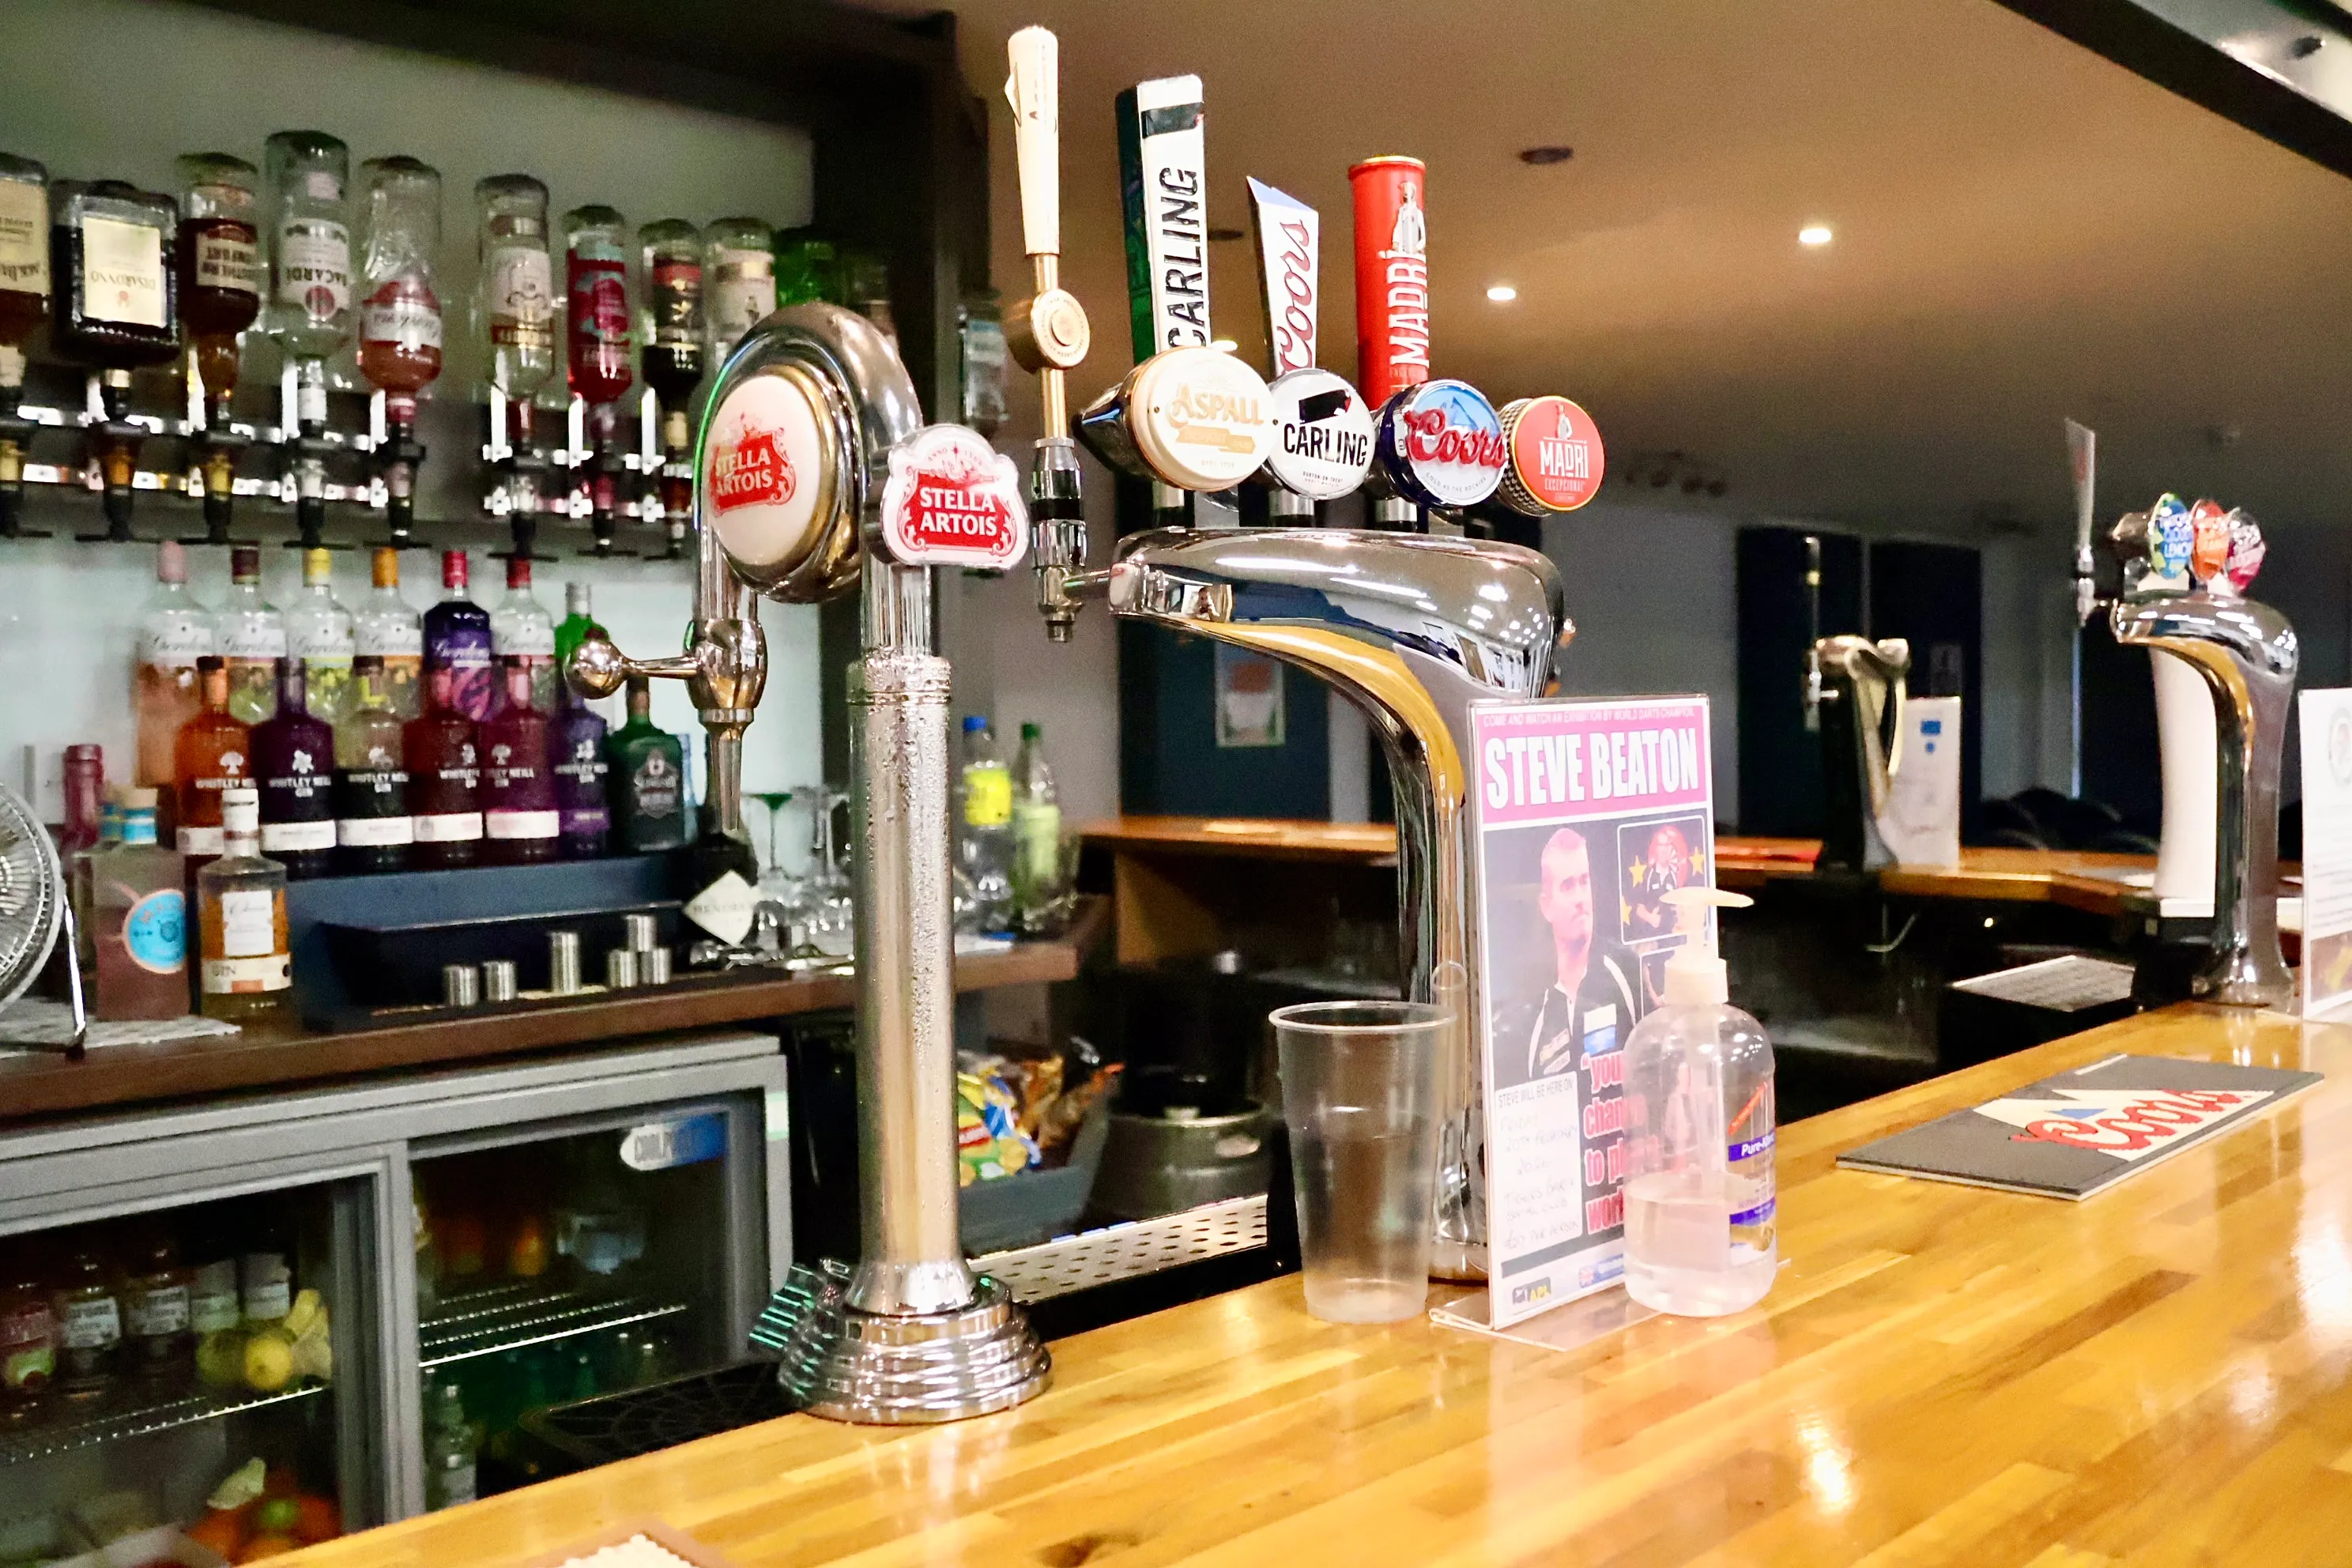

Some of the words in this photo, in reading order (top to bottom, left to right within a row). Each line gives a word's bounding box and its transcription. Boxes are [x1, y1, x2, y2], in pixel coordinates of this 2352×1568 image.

[1159, 167, 1207, 349] CARLING
[1276, 218, 1314, 375] Coors
[1165, 382, 1265, 429] ASPALL
[1283, 422, 1369, 468] CARLING
[1404, 408, 1506, 469] Coors
[714, 447, 771, 477] STELLA
[715, 468, 774, 497] ARTOIS
[919, 486, 996, 514] STELLA
[920, 511, 997, 537] ARTOIS
[1484, 733, 1585, 810] STEVE
[1589, 727, 1698, 801] BEATON
[1498, 1090, 1519, 1108] STEVE
[1521, 1087, 1535, 1102] WILL
[1536, 1084, 1545, 1099] BE
[1546, 1080, 1562, 1095] HERE
[1563, 1077, 1573, 1091] ON
[1584, 1148, 1605, 1187] to
